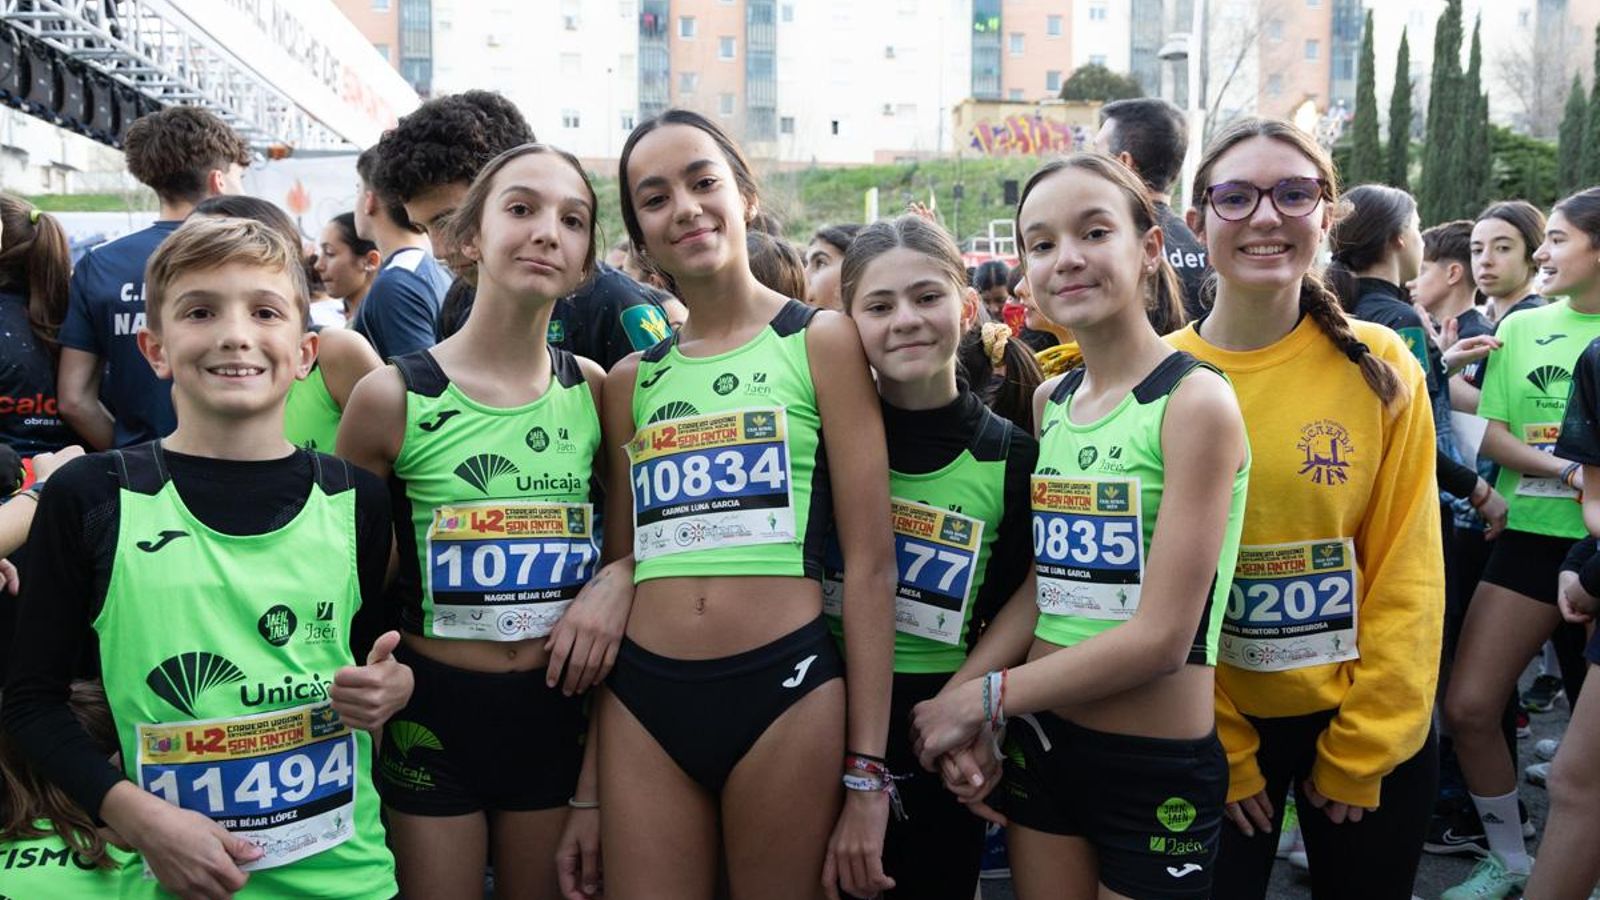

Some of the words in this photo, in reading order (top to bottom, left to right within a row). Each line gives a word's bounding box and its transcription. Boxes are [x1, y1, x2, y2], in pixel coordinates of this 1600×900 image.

[1163, 248, 1206, 269] der
[652, 427, 677, 450] 42
[1543, 427, 1558, 440] 42
[516, 473, 582, 493] Unicaja
[636, 447, 785, 506] 10834
[471, 509, 505, 533] 42
[506, 520, 529, 531] SAN
[1032, 515, 1136, 565] 0835
[436, 542, 593, 587] 10777
[484, 593, 516, 602] NAGORE
[186, 727, 227, 755] 42
[228, 737, 257, 750] SAN
[150, 741, 353, 812] 11494
[239, 816, 268, 828] BÉJAR
[270, 810, 298, 824] LÓPEZ
